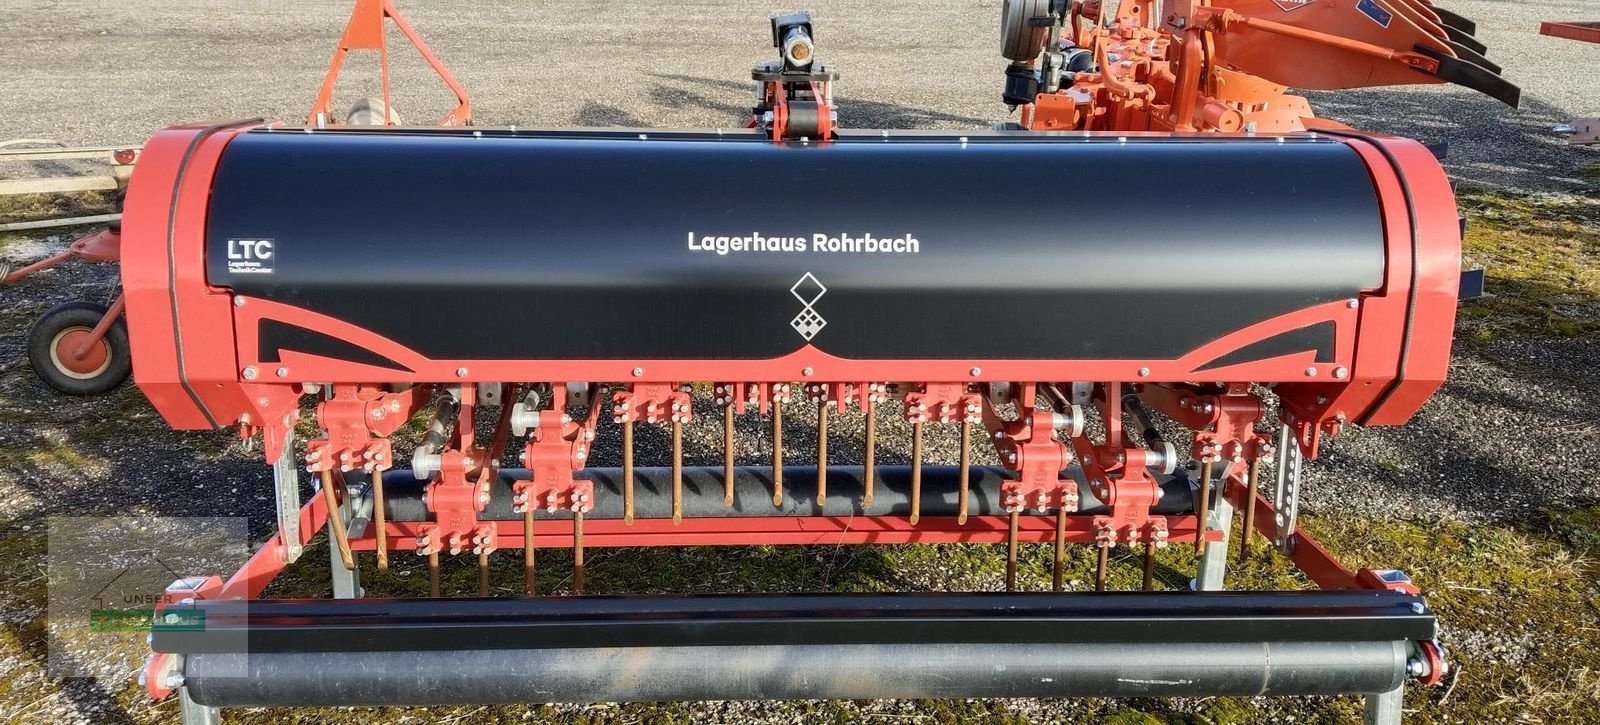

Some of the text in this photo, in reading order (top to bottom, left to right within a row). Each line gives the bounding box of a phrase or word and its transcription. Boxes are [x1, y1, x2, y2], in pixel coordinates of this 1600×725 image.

[228, 240, 272, 259] LTC
[688, 231, 919, 255] Lagerhaus Rohrbach
